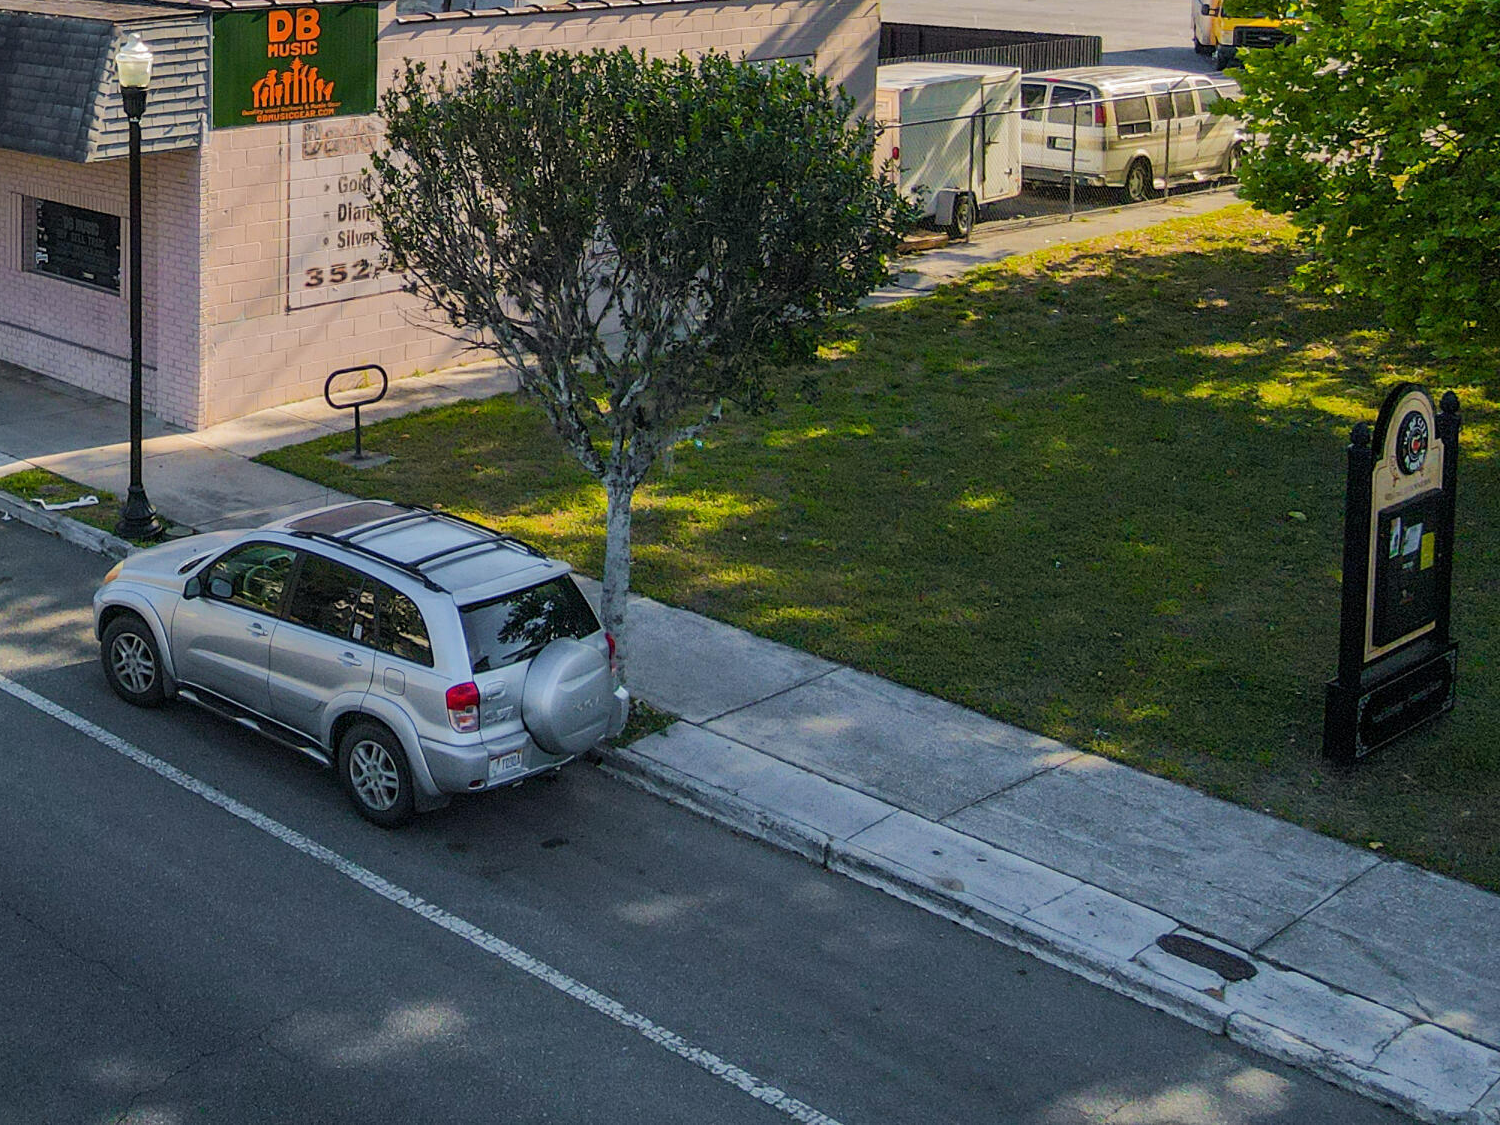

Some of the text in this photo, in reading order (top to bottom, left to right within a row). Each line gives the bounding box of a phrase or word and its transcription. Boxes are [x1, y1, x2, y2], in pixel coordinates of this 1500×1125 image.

[268, 8, 321, 42] DB
[267, 41, 318, 58] MUSIC
[257, 107, 335, 123] DBMUSICGEAR.COM
[338, 174, 371, 194] Gold
[337, 229, 376, 248] Silver
